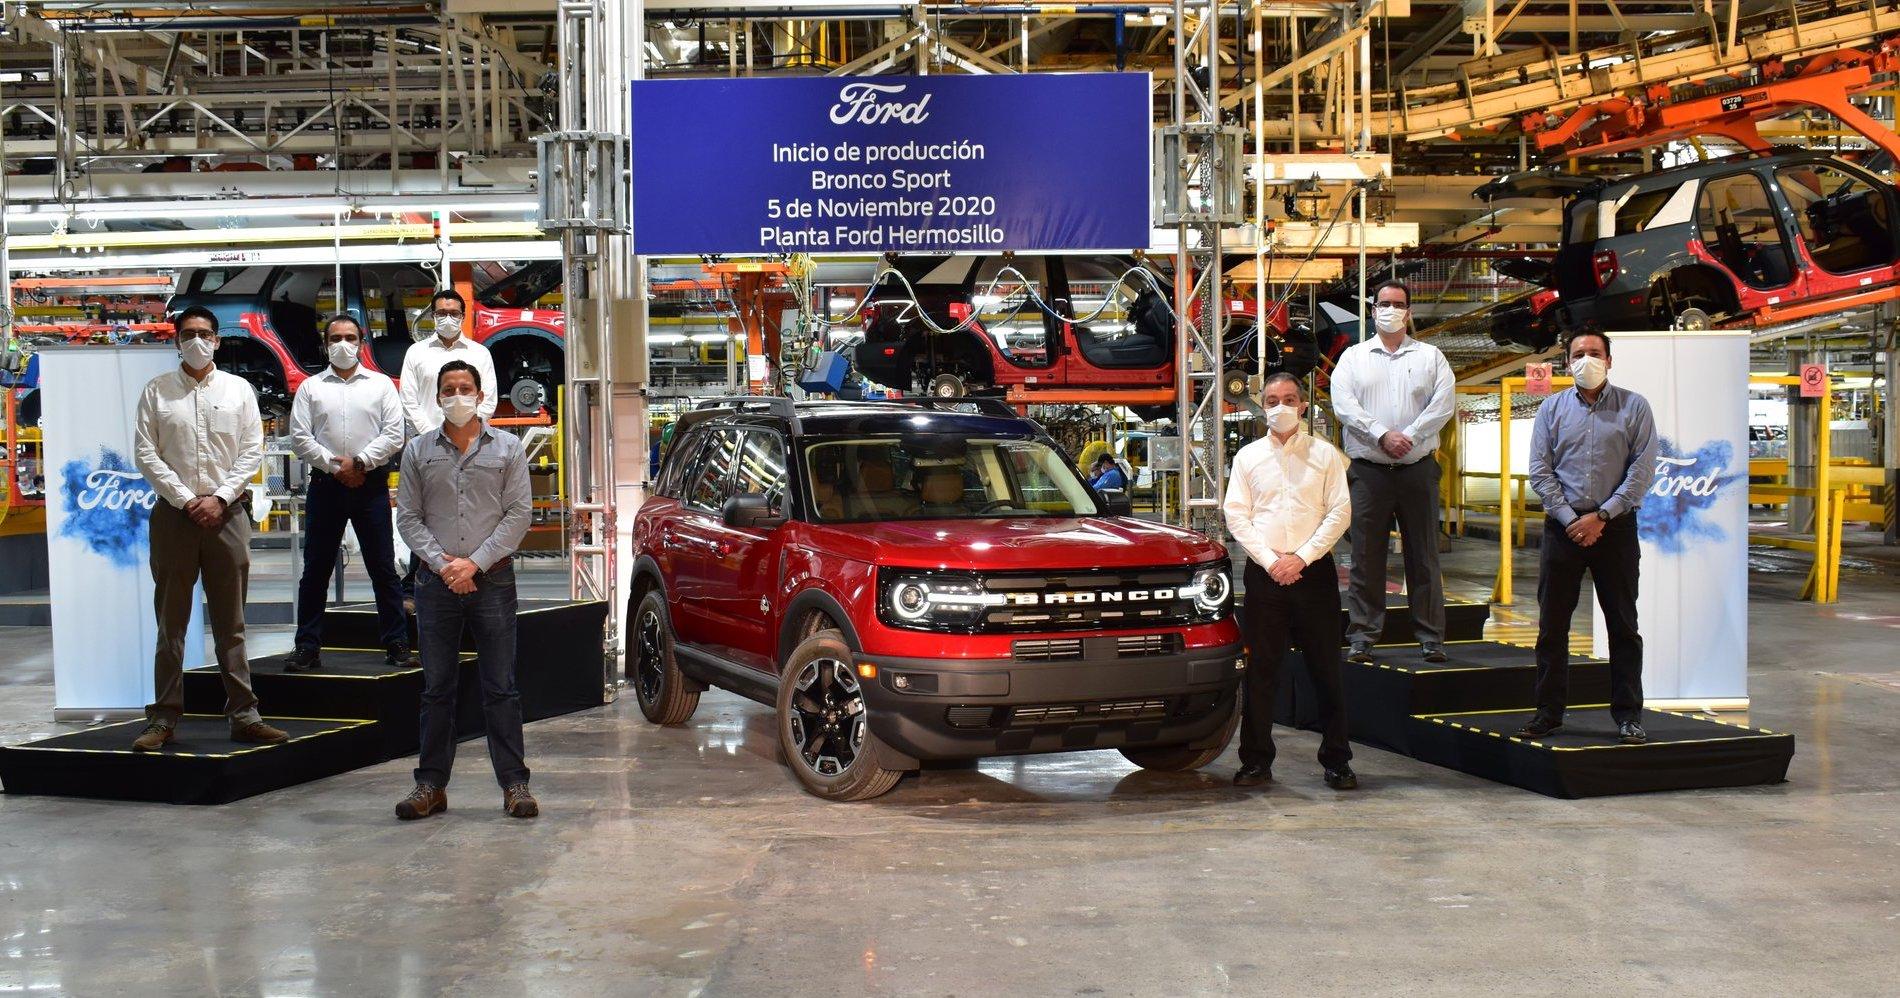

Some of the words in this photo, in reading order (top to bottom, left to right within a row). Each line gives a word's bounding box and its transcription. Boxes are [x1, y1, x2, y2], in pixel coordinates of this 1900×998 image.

[829, 83, 932, 124] Ford
[773, 143, 829, 162] Inicio
[834, 142, 861, 161] de
[866, 140, 985, 164] producción
[812, 170, 887, 190] Bronco
[892, 169, 951, 191] Sport
[768, 199, 781, 218] 5
[786, 198, 812, 217] de
[818, 197, 934, 217] Noviembre
[939, 196, 996, 216] 2020
[760, 227, 830, 246] Planta
[835, 226, 883, 245] Ford
[889, 224, 1004, 245] Hermosillo
[1015, 589, 1174, 605] BRONCO
